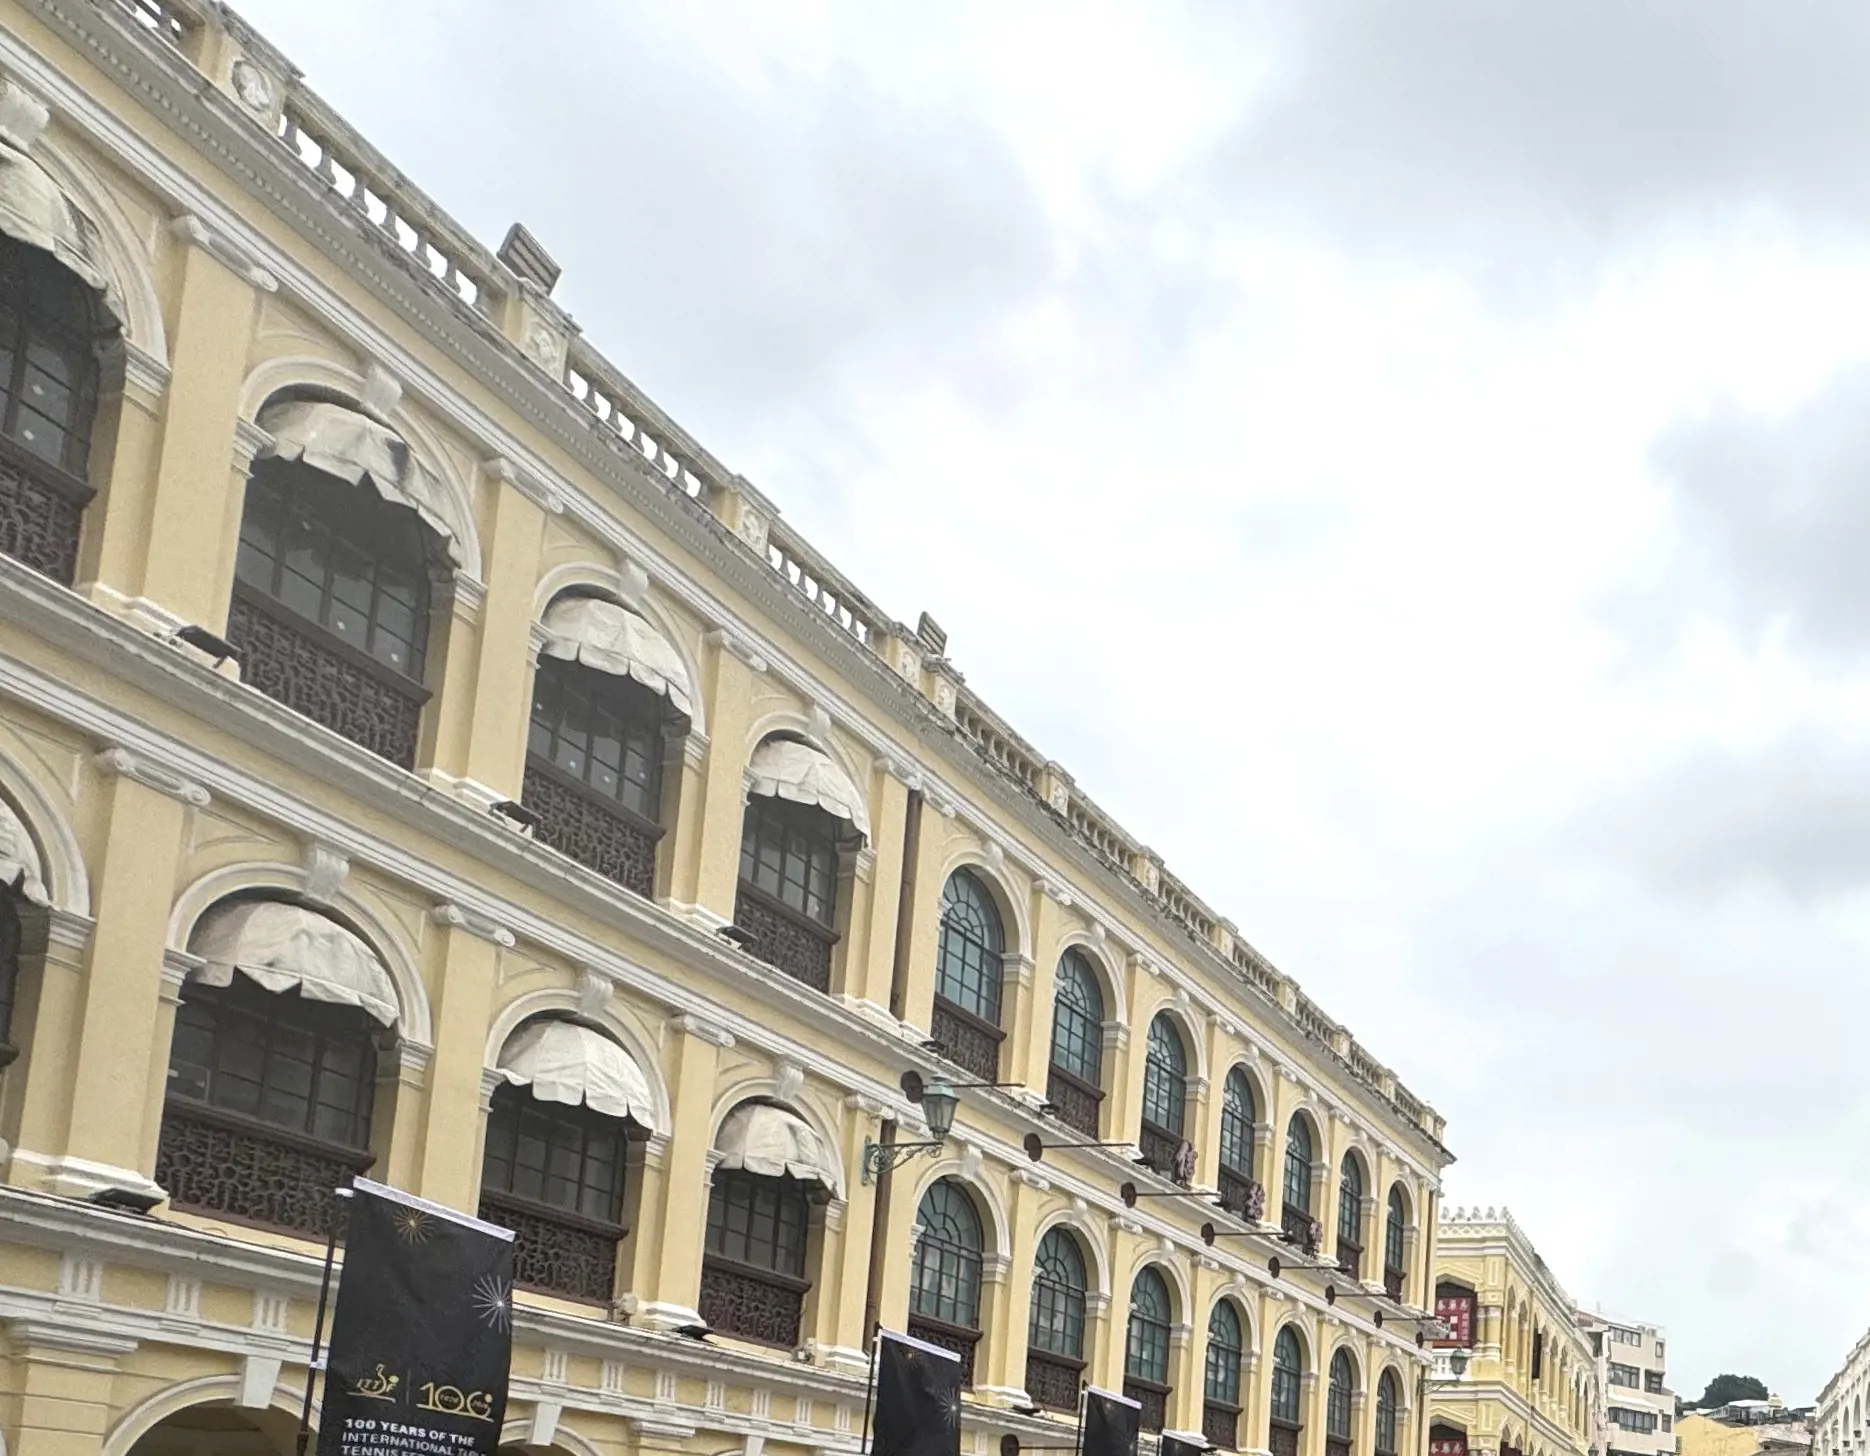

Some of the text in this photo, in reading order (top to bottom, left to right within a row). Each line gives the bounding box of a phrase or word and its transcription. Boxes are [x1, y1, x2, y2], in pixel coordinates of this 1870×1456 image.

[342, 1432, 454, 1456] INTERNATIONAL
[344, 1419, 475, 1447] 100 YEARS OF THE
